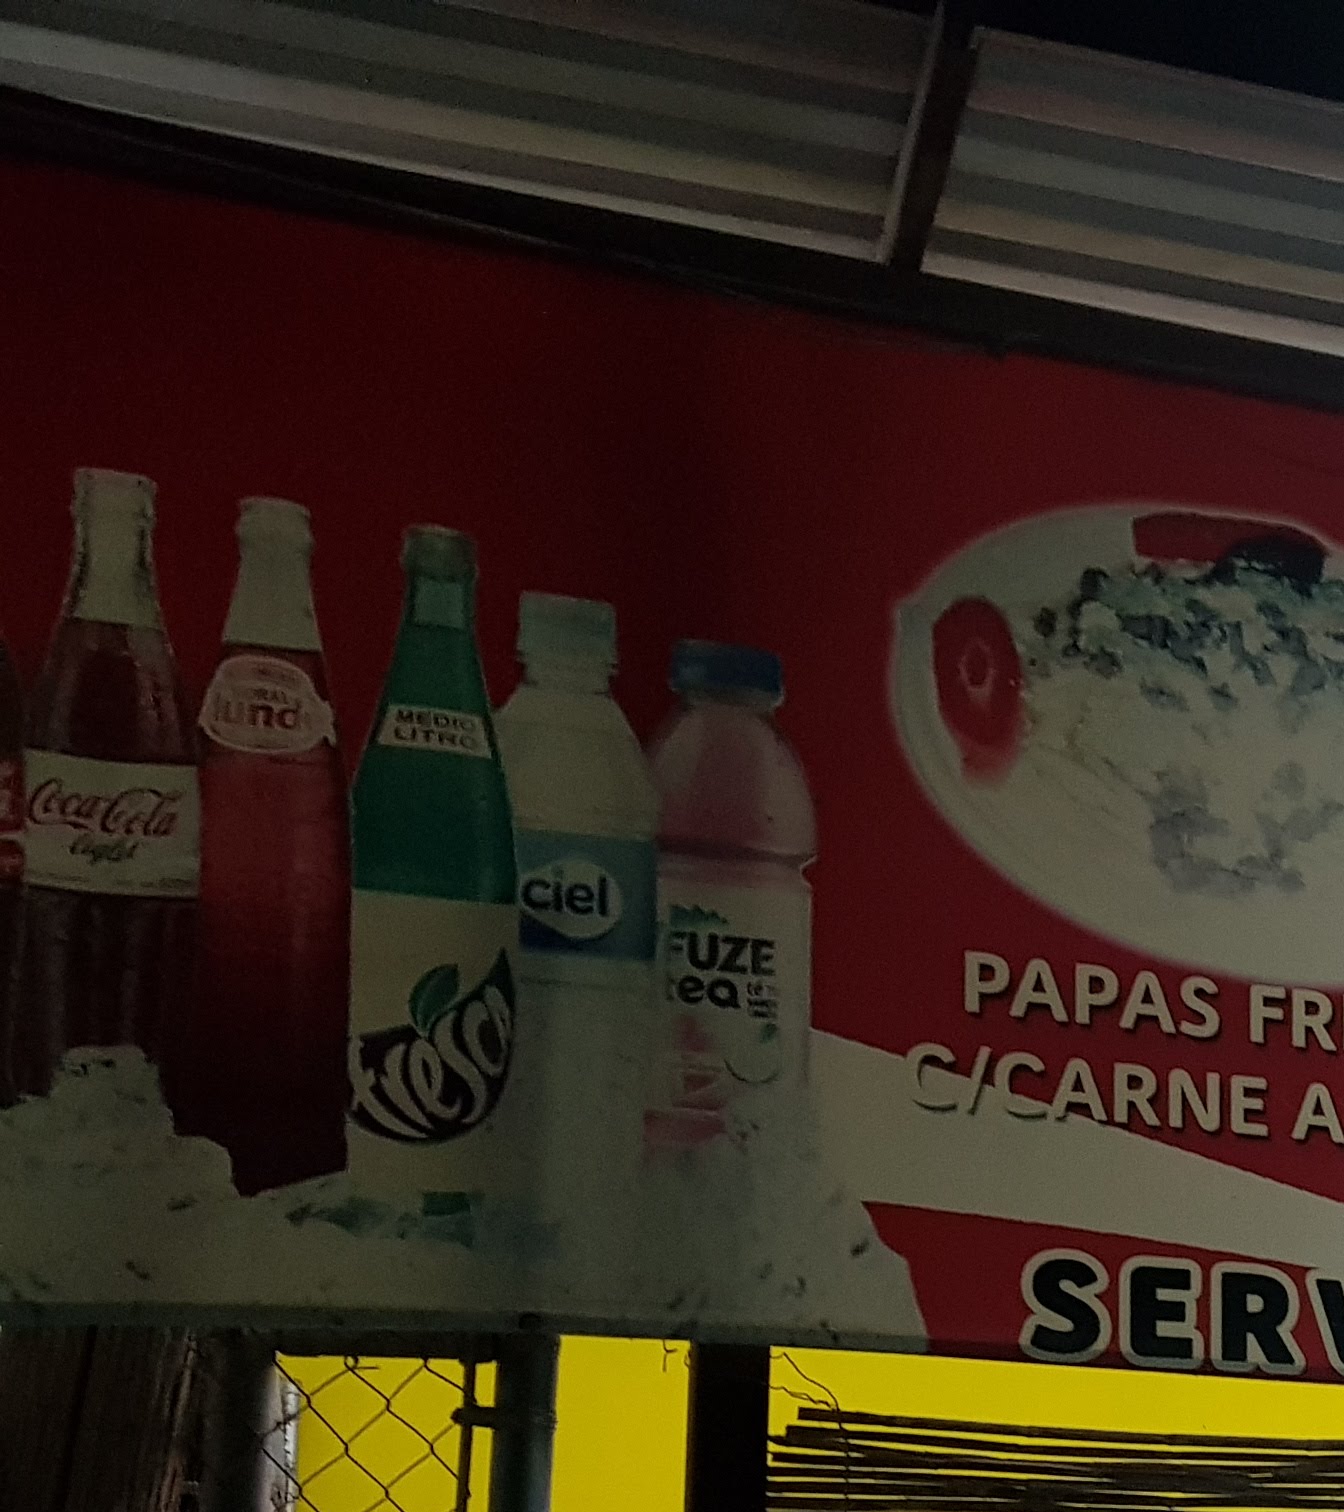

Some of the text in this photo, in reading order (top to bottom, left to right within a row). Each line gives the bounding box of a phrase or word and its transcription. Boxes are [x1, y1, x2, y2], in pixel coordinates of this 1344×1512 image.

[394, 727, 479, 749] LITRO
[396, 709, 477, 729] MEDIO
[521, 867, 608, 917] ciel
[668, 973, 741, 1008] ea
[963, 950, 1221, 1040] PAPAS
[905, 1041, 1271, 1137] C/CARNE
